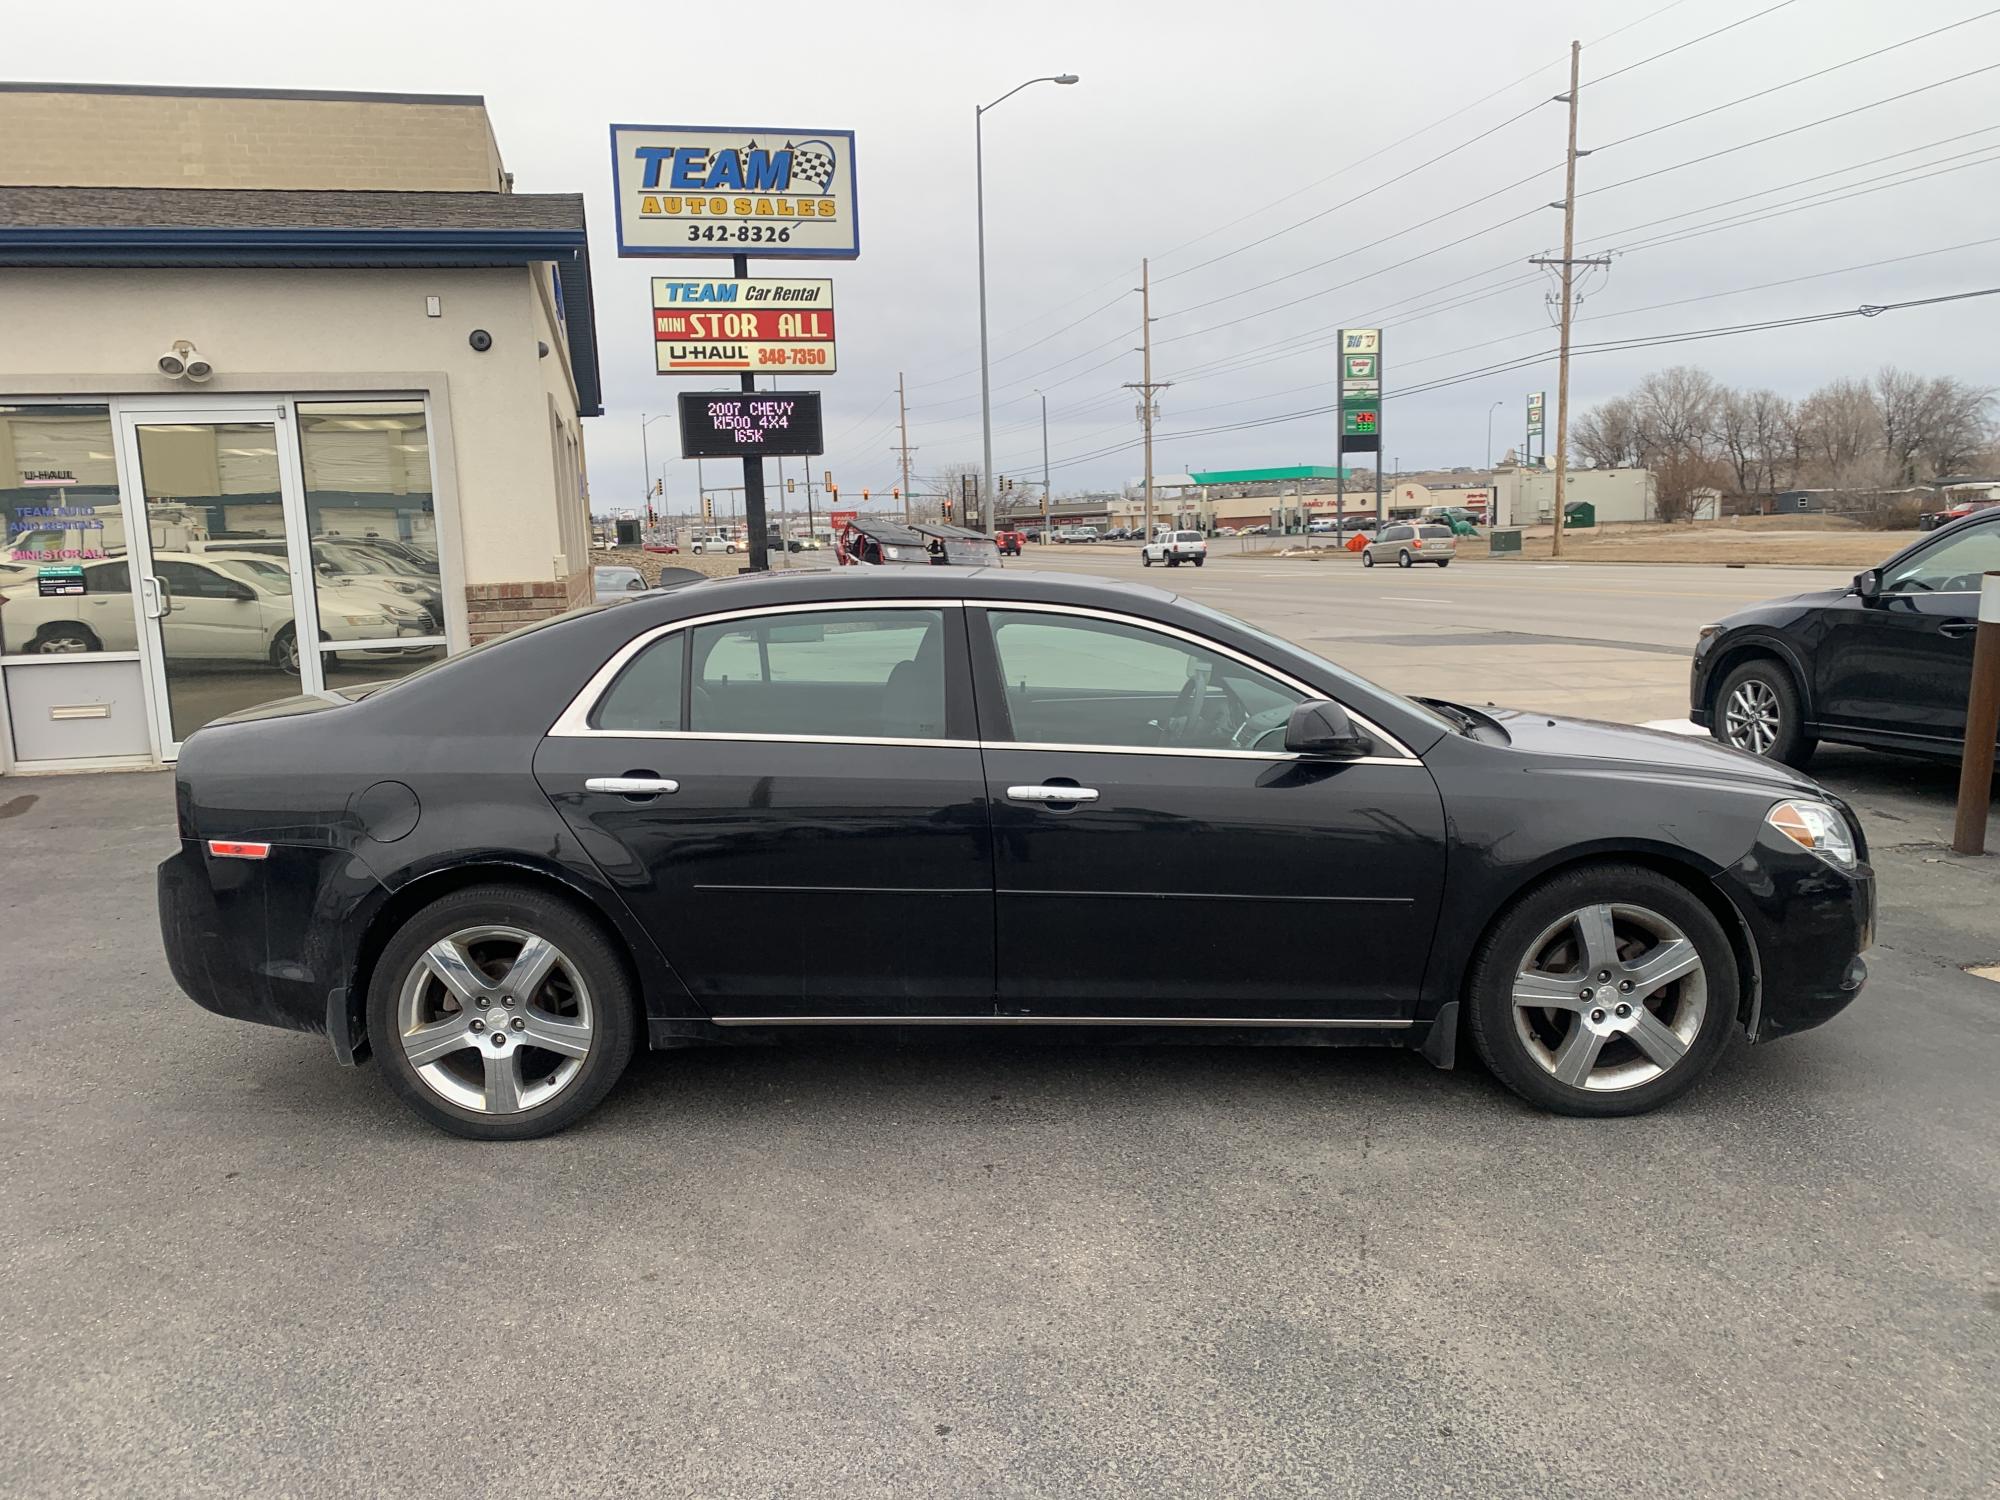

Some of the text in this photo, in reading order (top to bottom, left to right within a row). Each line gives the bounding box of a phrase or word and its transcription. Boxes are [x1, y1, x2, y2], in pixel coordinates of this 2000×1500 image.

[635, 147, 795, 191] TEAM
[687, 225, 791, 243] 342-8326
[666, 283, 821, 303] TEAM Car Rental
[657, 313, 828, 338] MINI STOR ALL
[669, 345, 826, 365] U-HAUL 348-7350
[707, 402, 794, 416] 2007 CHEVY
[758, 415, 789, 429] 4X4
[15, 507, 54, 517] TEAM
